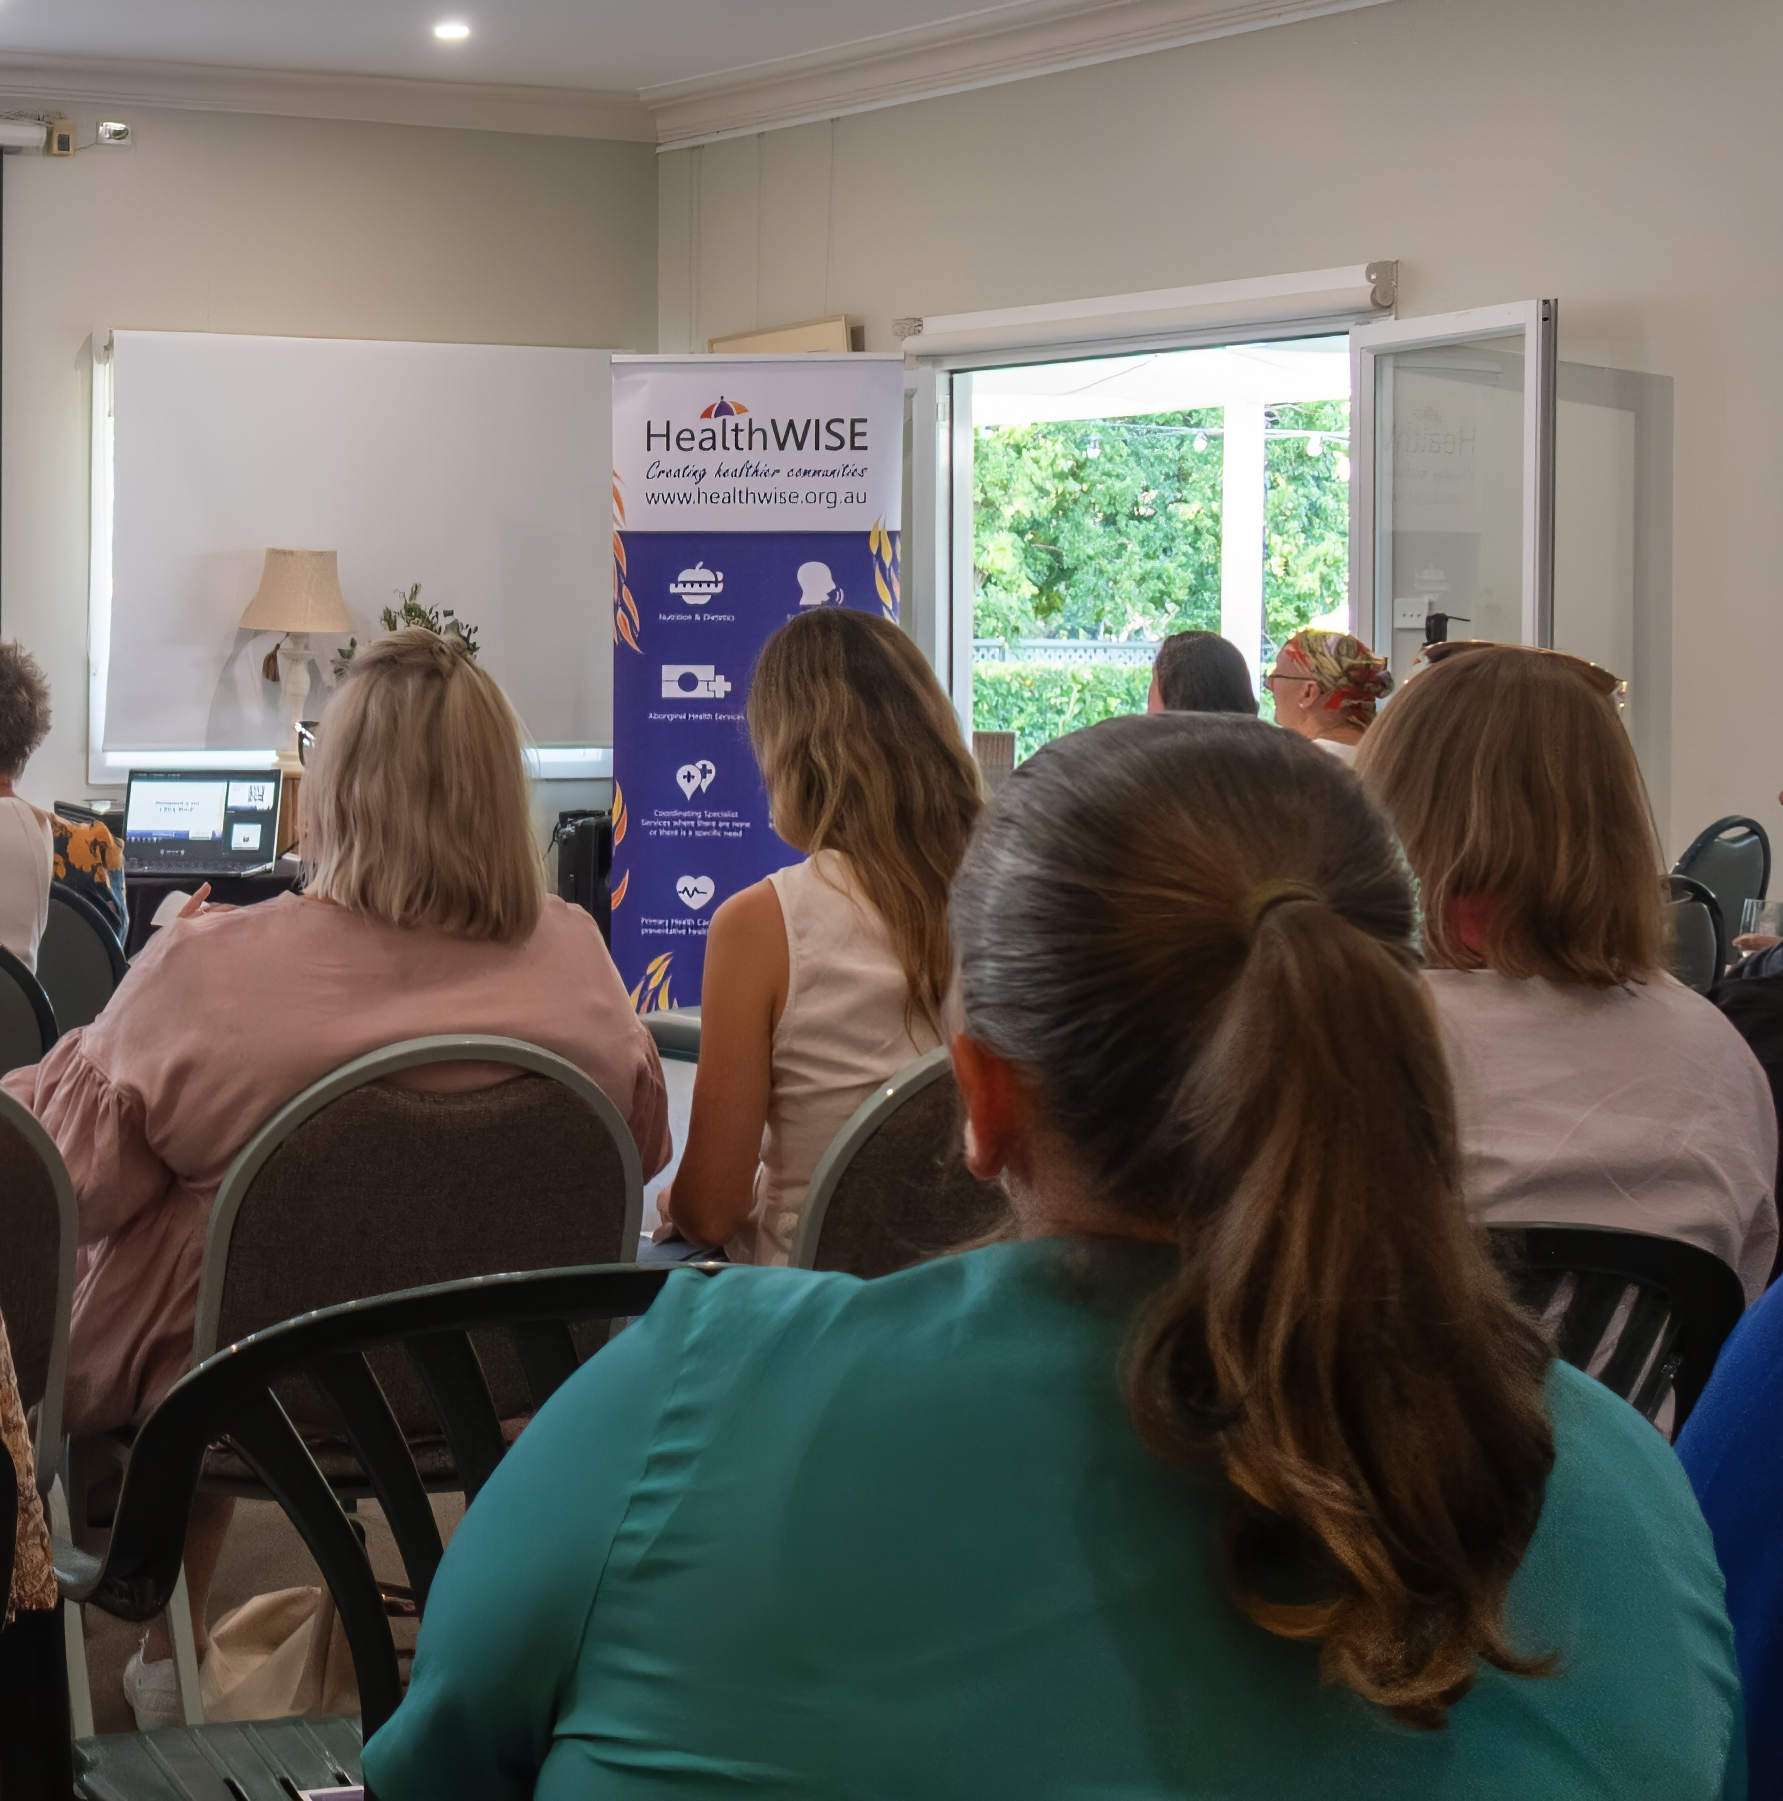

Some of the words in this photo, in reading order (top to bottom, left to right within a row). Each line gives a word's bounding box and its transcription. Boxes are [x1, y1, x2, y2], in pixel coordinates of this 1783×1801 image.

[646, 417, 869, 452] HealthWISE
[645, 460, 707, 485] Creating
[713, 459, 781, 479] healthier
[786, 463, 869, 479] communities
[644, 486, 868, 509] www.healthwise.org.au
[648, 711, 687, 722] Aboriginal
[688, 711, 713, 720] Health
[715, 711, 745, 721] Services
[653, 809, 702, 819] Coordinating
